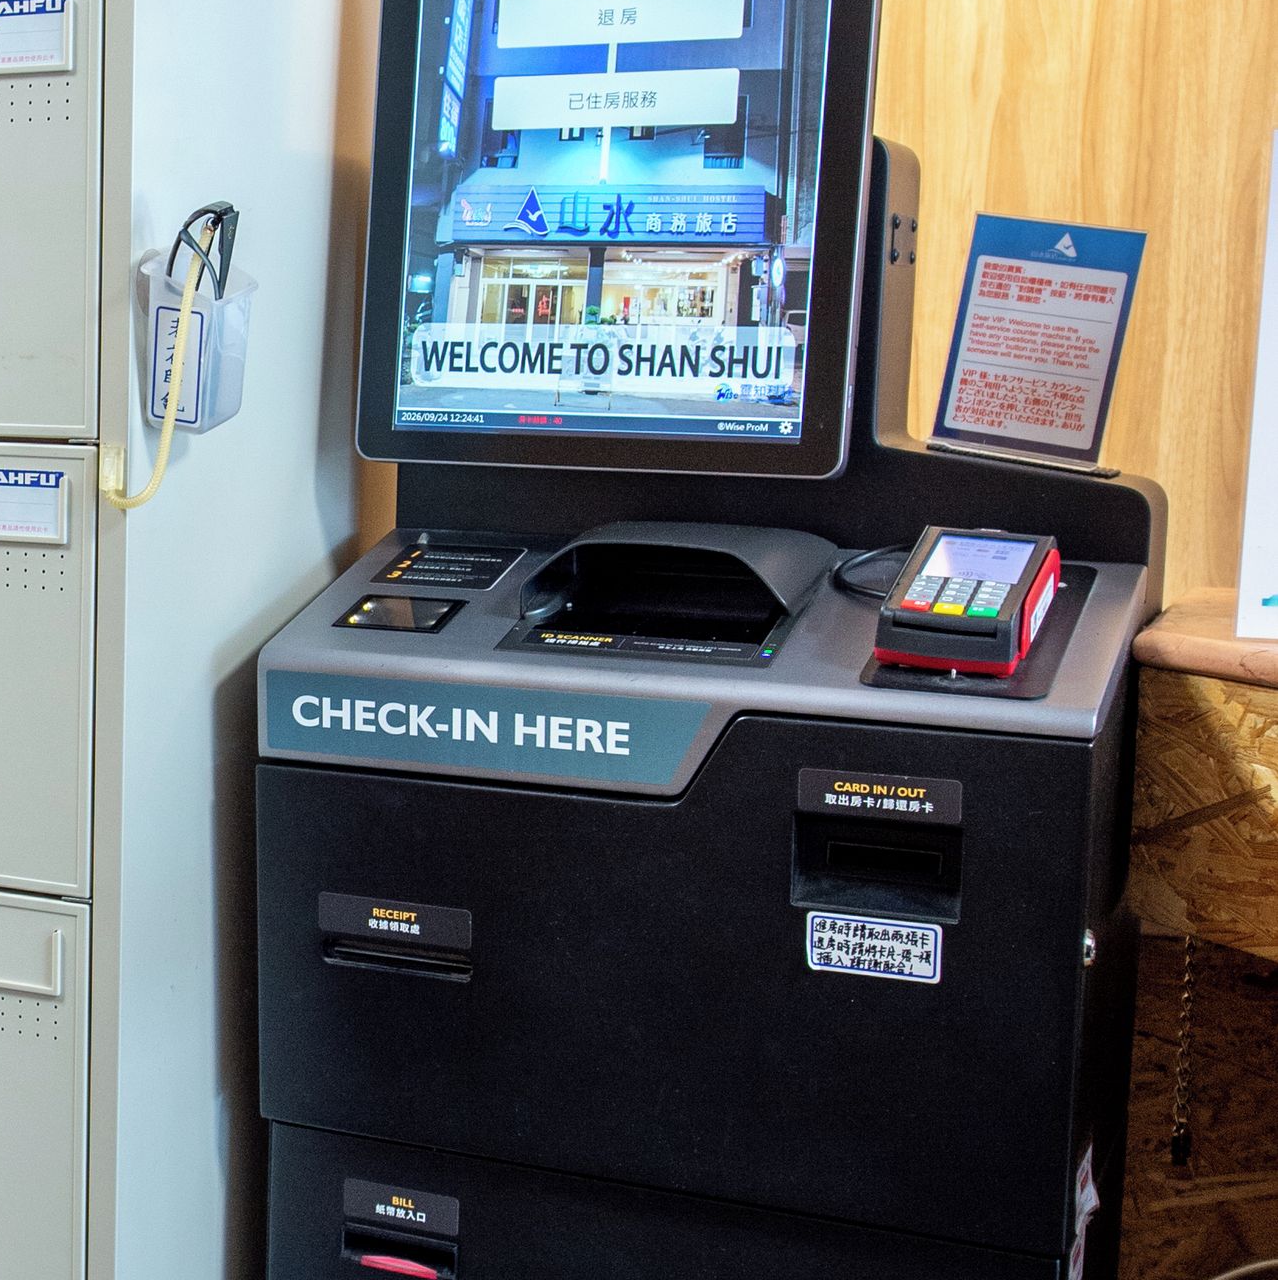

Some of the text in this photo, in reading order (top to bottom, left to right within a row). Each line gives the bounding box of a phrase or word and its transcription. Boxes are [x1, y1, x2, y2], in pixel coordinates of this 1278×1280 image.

[569, 91, 657, 111] 已住房服務
[557, 190, 738, 238] 山水 商務旅店
[972, 323, 1010, 333] self-service
[1013, 329, 1039, 337] counter
[1009, 318, 1042, 328] Welcome
[1004, 335, 1038, 345] questions,
[1041, 340, 1065, 349] please
[1066, 344, 1086, 352] press
[1006, 343, 1027, 351] button
[422, 341, 782, 380] WELCOME TO SHAN SHUI
[967, 347, 998, 355] someone
[1014, 352, 1032, 360] serve
[1053, 358, 1073, 366] Thank
[1051, 383, 1089, 393] カウンター
[401, 412, 484, 423] 2026/09/24 12:24:41
[746, 423, 769, 433] ProM
[556, 634, 613, 643] SCANNER
[292, 695, 630, 756] CHECK-IN HERE
[834, 781, 870, 794] CARD
[873, 785, 887, 795] IN
[897, 786, 927, 798] OUT
[824, 793, 934, 814] 取出房卡/歸還房卡
[372, 907, 417, 922] RECEIPT
[392, 1196, 415, 1209] BILL
[375, 1204, 426, 1223] 紙幣放入口
